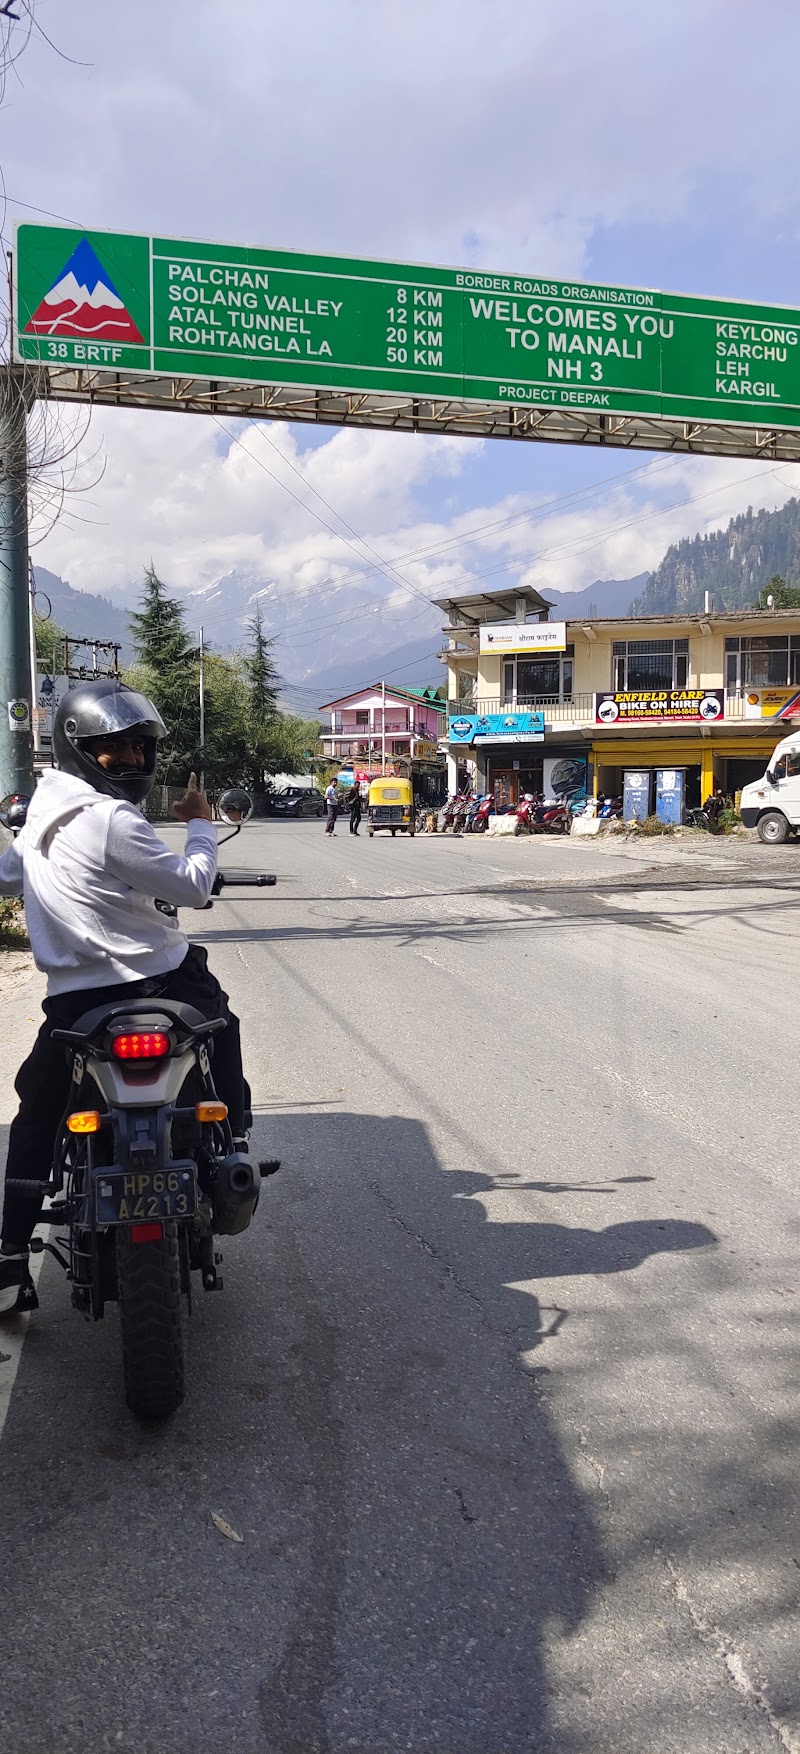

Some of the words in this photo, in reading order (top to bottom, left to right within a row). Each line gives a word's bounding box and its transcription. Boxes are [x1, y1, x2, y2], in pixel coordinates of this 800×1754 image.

[168, 264, 269, 290] PALCHAN
[168, 284, 258, 309] SOLANG
[263, 294, 343, 317] VALLEY
[396, 288, 407, 304] 8
[413, 289, 443, 308] KM
[456, 274, 511, 291] BORDER
[513, 280, 558, 296] ROADS
[561, 285, 654, 306] ORGANISATION
[168, 305, 222, 326] ATAL
[227, 311, 311, 334] TUNNEL
[386, 307, 407, 324] 12
[413, 309, 443, 328] KM
[469, 297, 617, 332] WELCOMES
[623, 313, 674, 339] YOU
[169, 325, 301, 354] ROHTANGLA
[306, 339, 333, 356] LA
[386, 326, 408, 344] 20
[413, 329, 443, 347] KM
[505, 327, 540, 350] TO
[547, 331, 642, 360] MANALI
[716, 322, 798, 346] KEYLONG
[47, 342, 68, 358] 38
[74, 344, 122, 362] BRTF
[386, 346, 408, 364] 50
[413, 349, 443, 367] KM
[715, 341, 787, 363] SARCHU
[547, 357, 582, 380] NH
[590, 361, 603, 382] 3
[715, 360, 749, 377] LEH
[499, 385, 557, 401] PROJECT
[560, 391, 610, 406] DEEPAK
[715, 378, 781, 398] KARGIL
[614, 692, 667, 703] ENFIELD
[670, 690, 705, 701] CARE
[619, 701, 648, 710] BIKE
[650, 701, 668, 709] ON
[670, 700, 700, 708] HIRE
[123, 1172, 180, 1197] HP66
[118, 1193, 188, 1220] A4213
